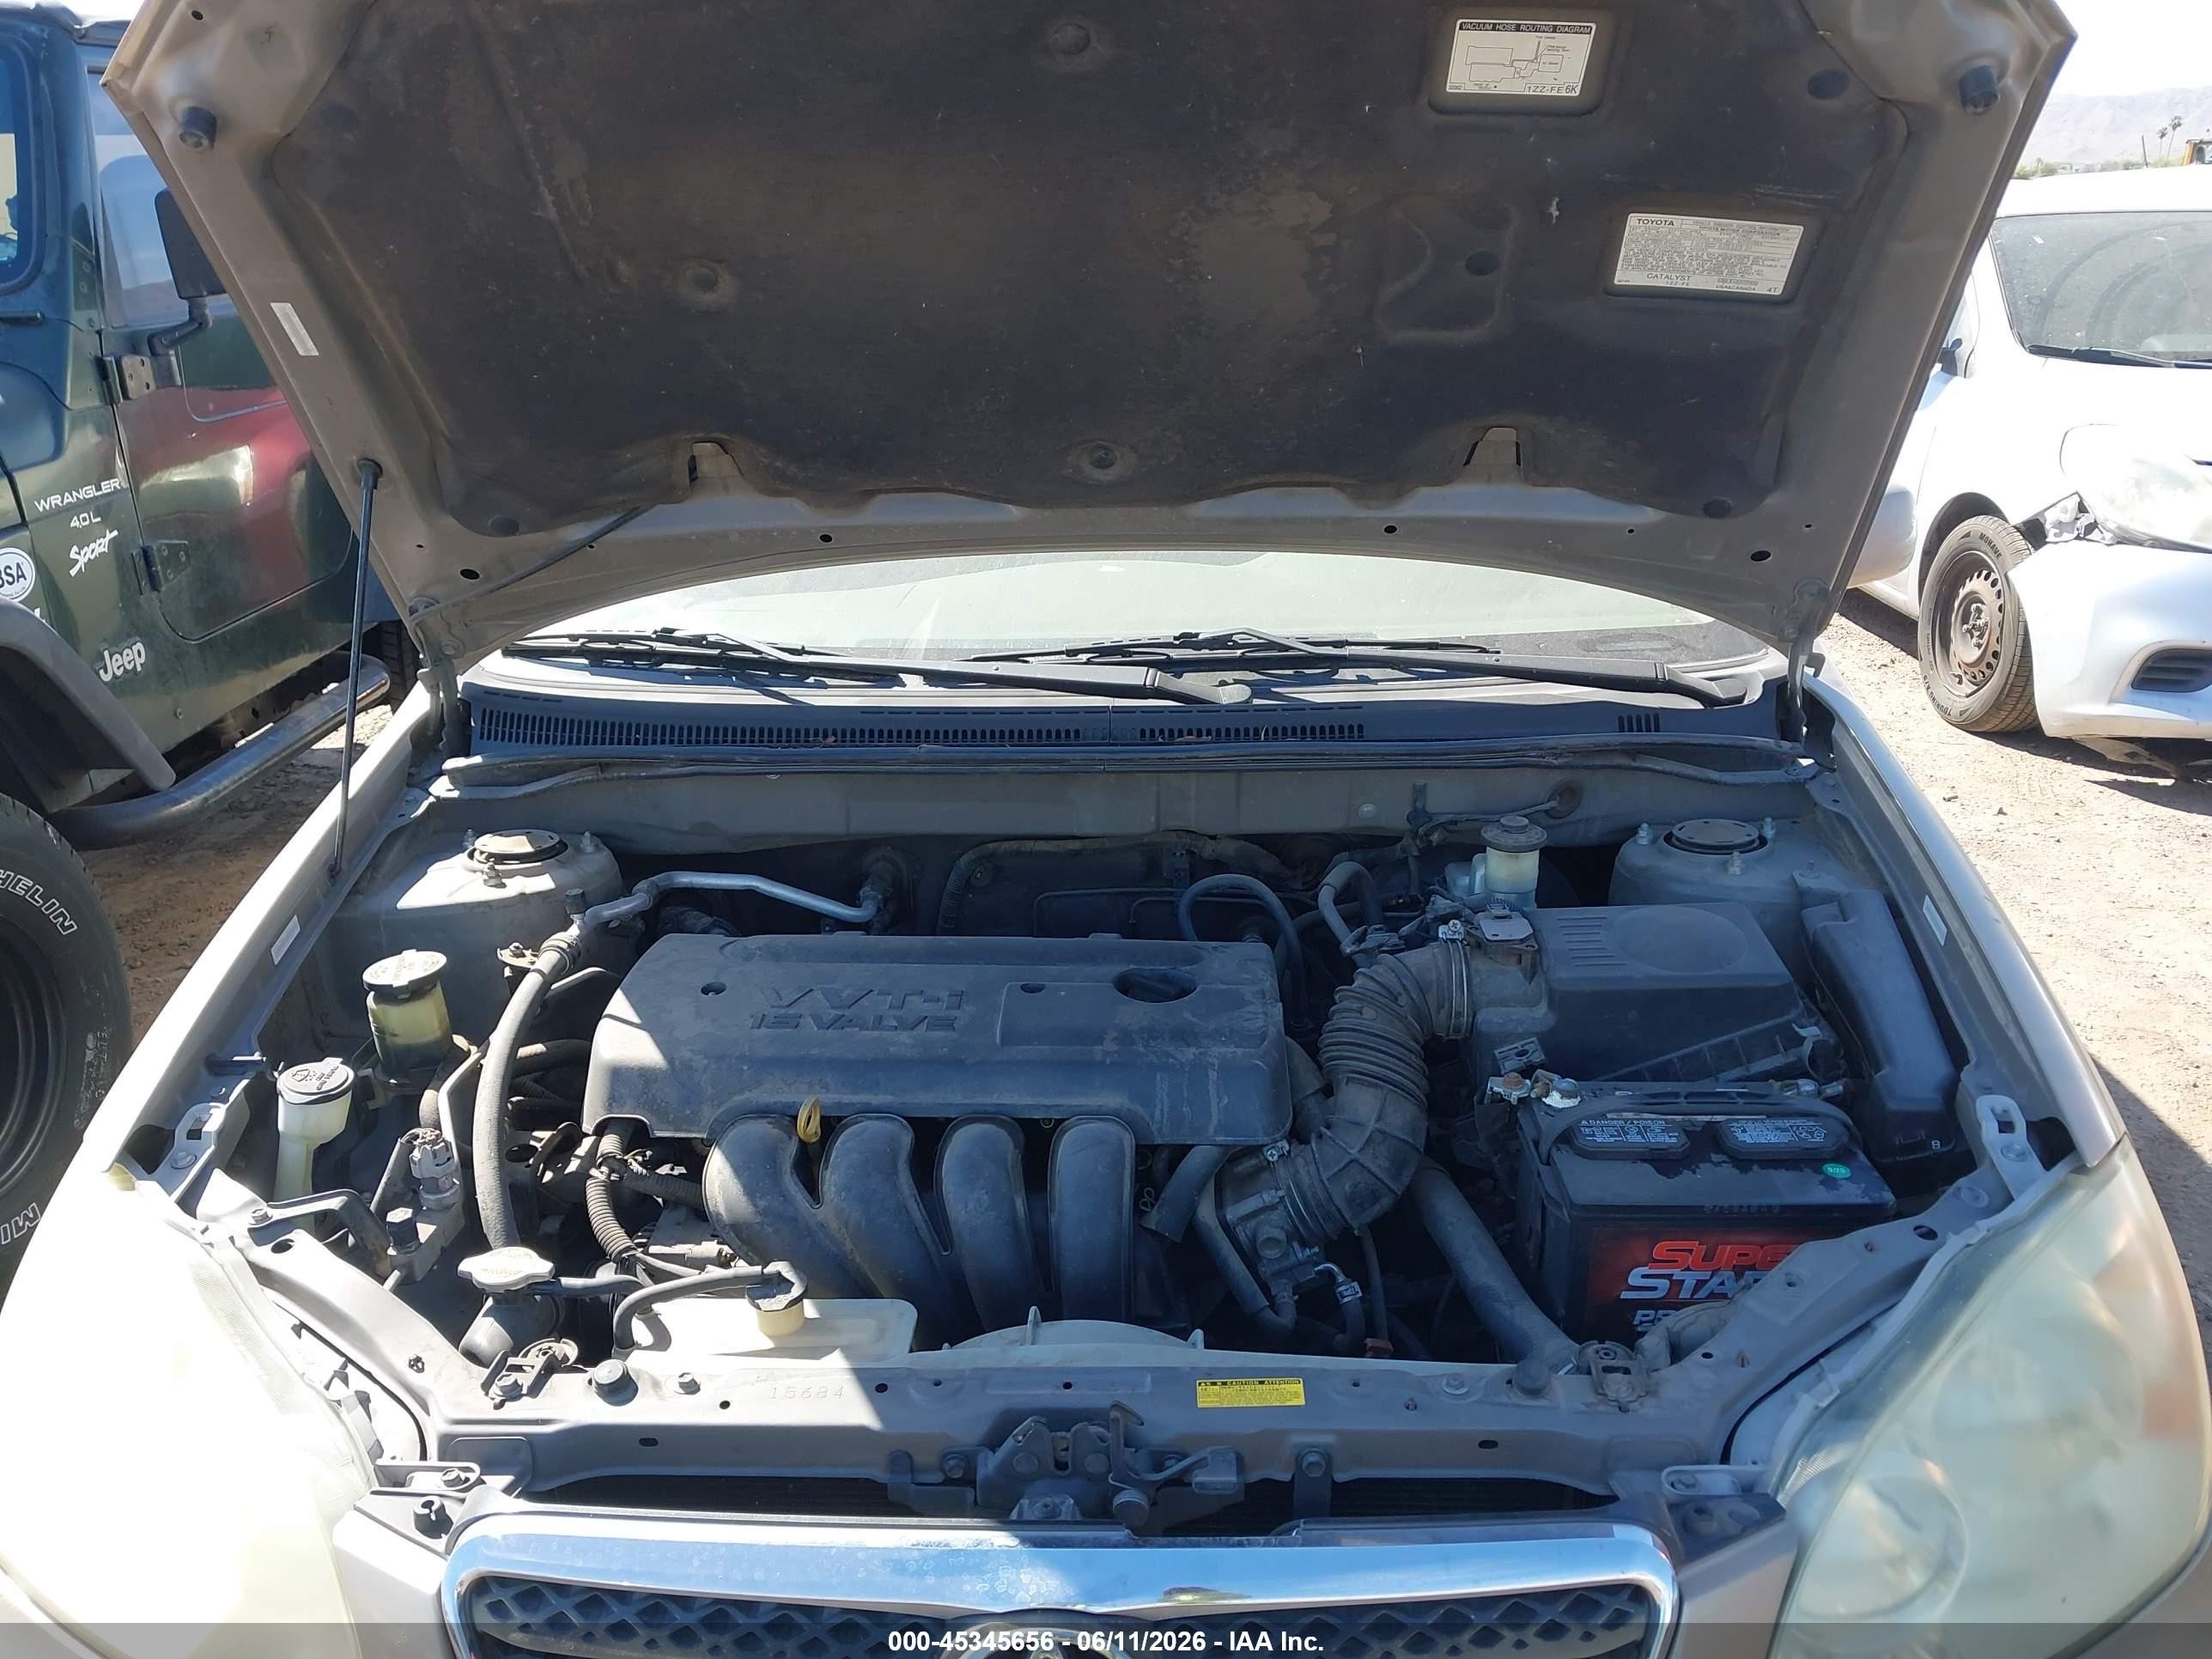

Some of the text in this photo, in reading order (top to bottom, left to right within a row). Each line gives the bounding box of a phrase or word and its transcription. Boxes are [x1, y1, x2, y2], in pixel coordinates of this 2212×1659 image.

[1462, 22, 1493, 31] VACUUM
[1496, 23, 1516, 32] HOSE
[1520, 24, 1553, 33] ROUTING
[1565, 84, 1579, 94] 6K
[1636, 218, 1675, 227] TOYOTA
[1646, 272, 1691, 282] CATALYST
[34, 477, 122, 513] WRANGLER
[1978, 532, 2002, 560] MOHAVE
[99, 641, 146, 682] Jeep
